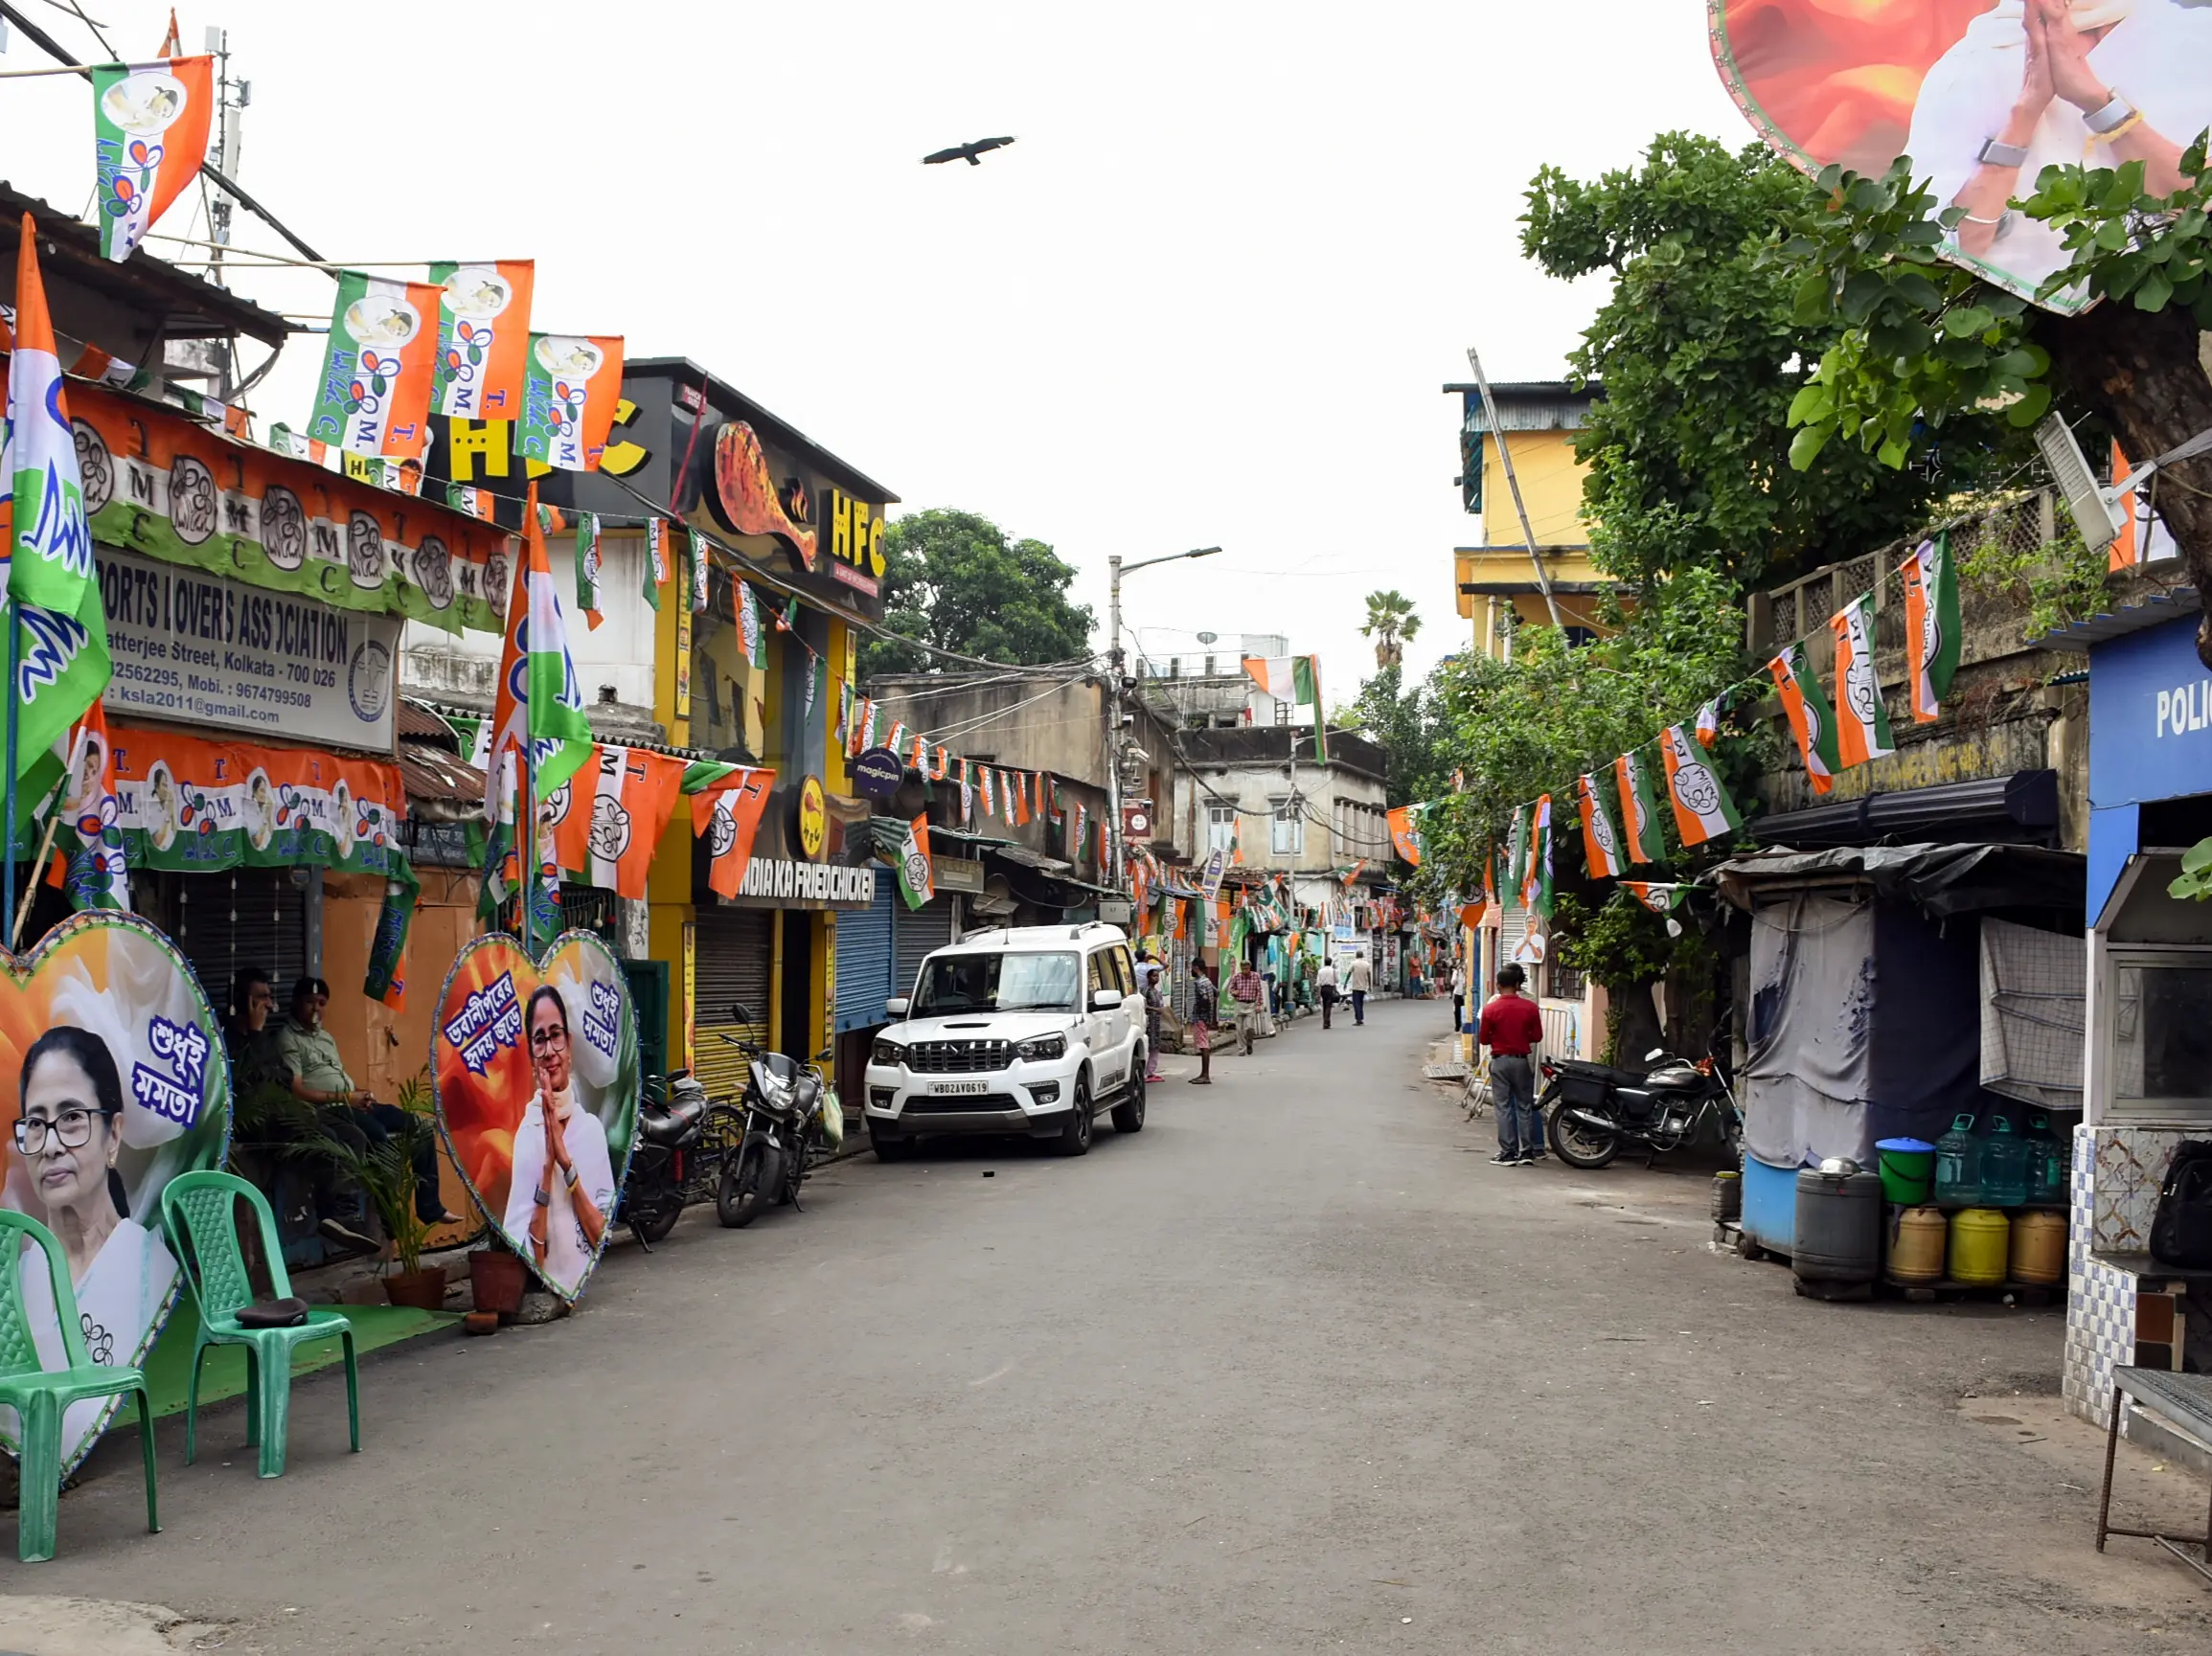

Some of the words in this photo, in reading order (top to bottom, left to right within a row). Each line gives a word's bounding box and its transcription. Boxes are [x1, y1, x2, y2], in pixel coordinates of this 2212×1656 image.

[452, 387, 474, 415] M.
[355, 420, 378, 448] M.
[129, 465, 154, 507] M
[132, 512, 150, 542] C
[316, 526, 341, 558] M
[832, 488, 886, 578] HFC
[232, 540, 246, 569] C
[320, 566, 336, 593] C
[164, 576, 235, 644] LOVERS
[171, 640, 219, 672] Street,
[224, 650, 275, 677] Kolkata
[287, 663, 309, 684] 700
[313, 668, 336, 688] 026
[121, 686, 280, 724] ksla2011@gmail.com
[188, 673, 224, 694] Mobi.
[236, 683, 311, 708] 9674799508
[2157, 679, 2212, 738] POLI
[113, 748, 130, 772] T.
[601, 752, 619, 778] M
[626, 762, 646, 783] T
[856, 764, 900, 782] magicpin
[217, 797, 237, 818] M.
[743, 783, 763, 800] T
[446, 973, 513, 1044] ভবানীপুরের
[591, 983, 620, 1022] শুধুই
[492, 1006, 521, 1044] জুড়ে
[583, 1014, 615, 1055] মমতা
[152, 1022, 207, 1080] শুধুই
[136, 1068, 200, 1124] মমতা
